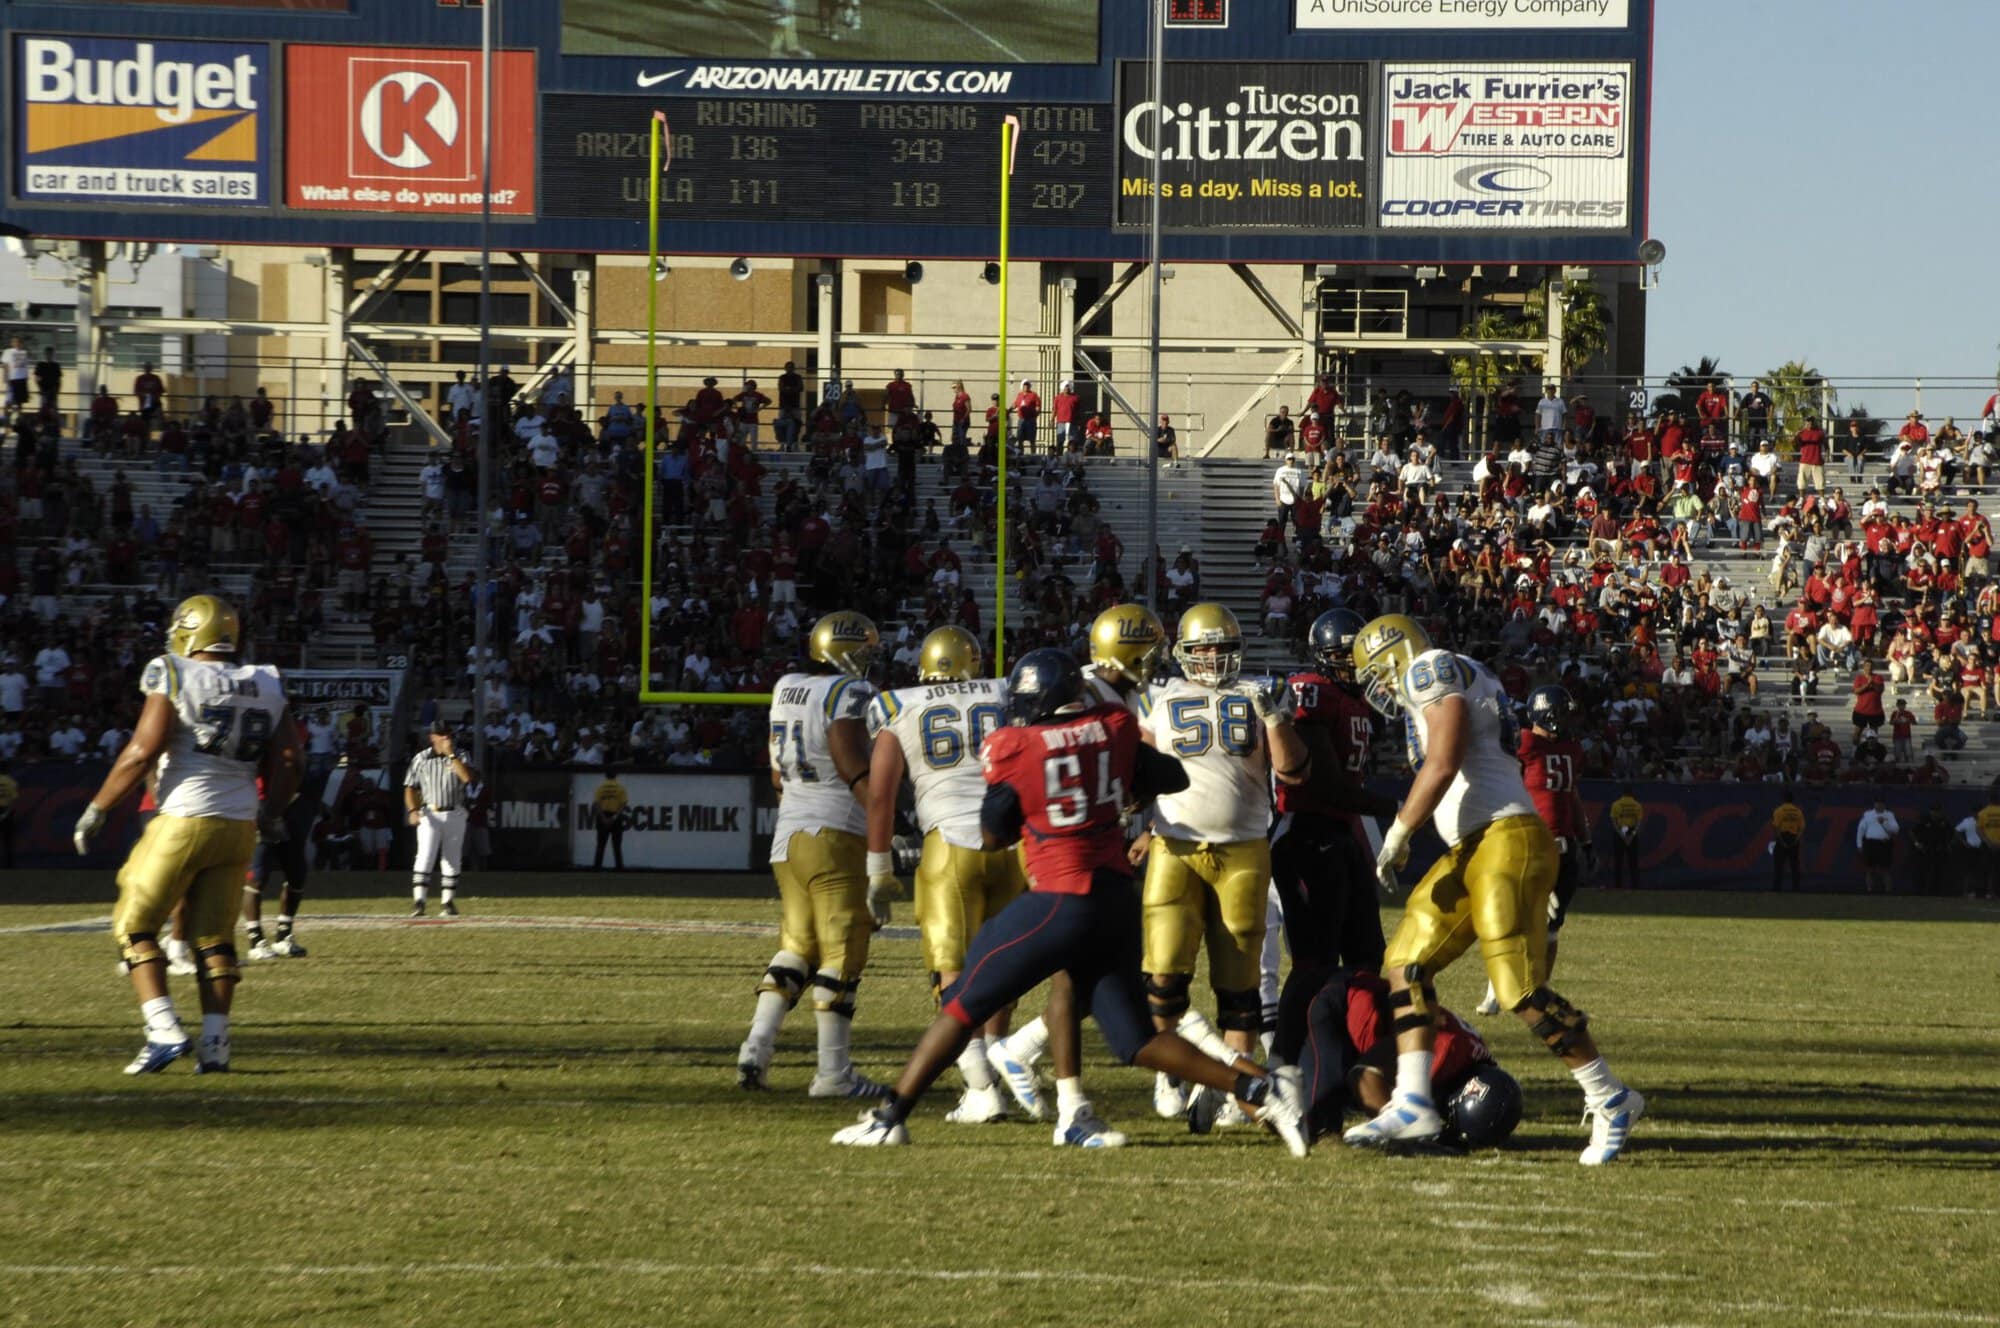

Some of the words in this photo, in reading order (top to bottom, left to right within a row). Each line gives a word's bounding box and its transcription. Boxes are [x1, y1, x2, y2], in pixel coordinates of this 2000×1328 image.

[1310, 0, 1325, 13] A
[1332, 0, 1432, 13] UniSource
[1440, 0, 1507, 17] Energy
[1514, 0, 1608, 16] Company
[25, 38, 258, 123] Budget
[685, 66, 1013, 94] ARIZONAATHLETICS.COM
[1393, 78, 1471, 99] Jack
[1485, 78, 1621, 101] Furrier's
[1240, 86, 1361, 116] Tucson
[697, 100, 817, 128] RUSHING
[860, 104, 977, 131] PASSING
[1016, 106, 1101, 132] TOTAL
[1392, 102, 1621, 152] WESTERN
[1123, 101, 1365, 161] Citizen
[1460, 133, 1498, 146] TIRE
[1503, 133, 1515, 147] &
[1520, 133, 1566, 148] AUTO
[1570, 134, 1615, 148] CARE
[729, 135, 779, 161] 136
[890, 138, 944, 164] 343
[1032, 140, 1087, 165] 479
[31, 172, 68, 190] car
[76, 171, 117, 192] and
[126, 172, 185, 193] truck
[192, 175, 252, 196] sales
[300, 185, 350, 201] What
[353, 186, 392, 203] else
[395, 187, 421, 204] do
[422, 189, 457, 207] you
[459, 189, 519, 205] ned?
[729, 178, 780, 205] 111
[891, 181, 942, 208] 113
[1031, 183, 1086, 209] 287
[1121, 178, 1174, 197] Miss
[1179, 183, 1193, 198] a
[1199, 179, 1243, 201] day.
[1250, 179, 1303, 197] Miss
[1308, 184, 1322, 198] a
[1328, 180, 1363, 199] lot.
[825, 383, 841, 401] 28
[1629, 391, 1646, 409] 29
[925, 682, 993, 701] JOSEPH
[919, 702, 1006, 770] 60
[1167, 695, 1257, 759] 58
[771, 720, 821, 783] 71
[1045, 751, 1123, 828] 54
[500, 801, 562, 829] MILK
[578, 804, 673, 831] MSCLE
[679, 806, 739, 832] MILK
